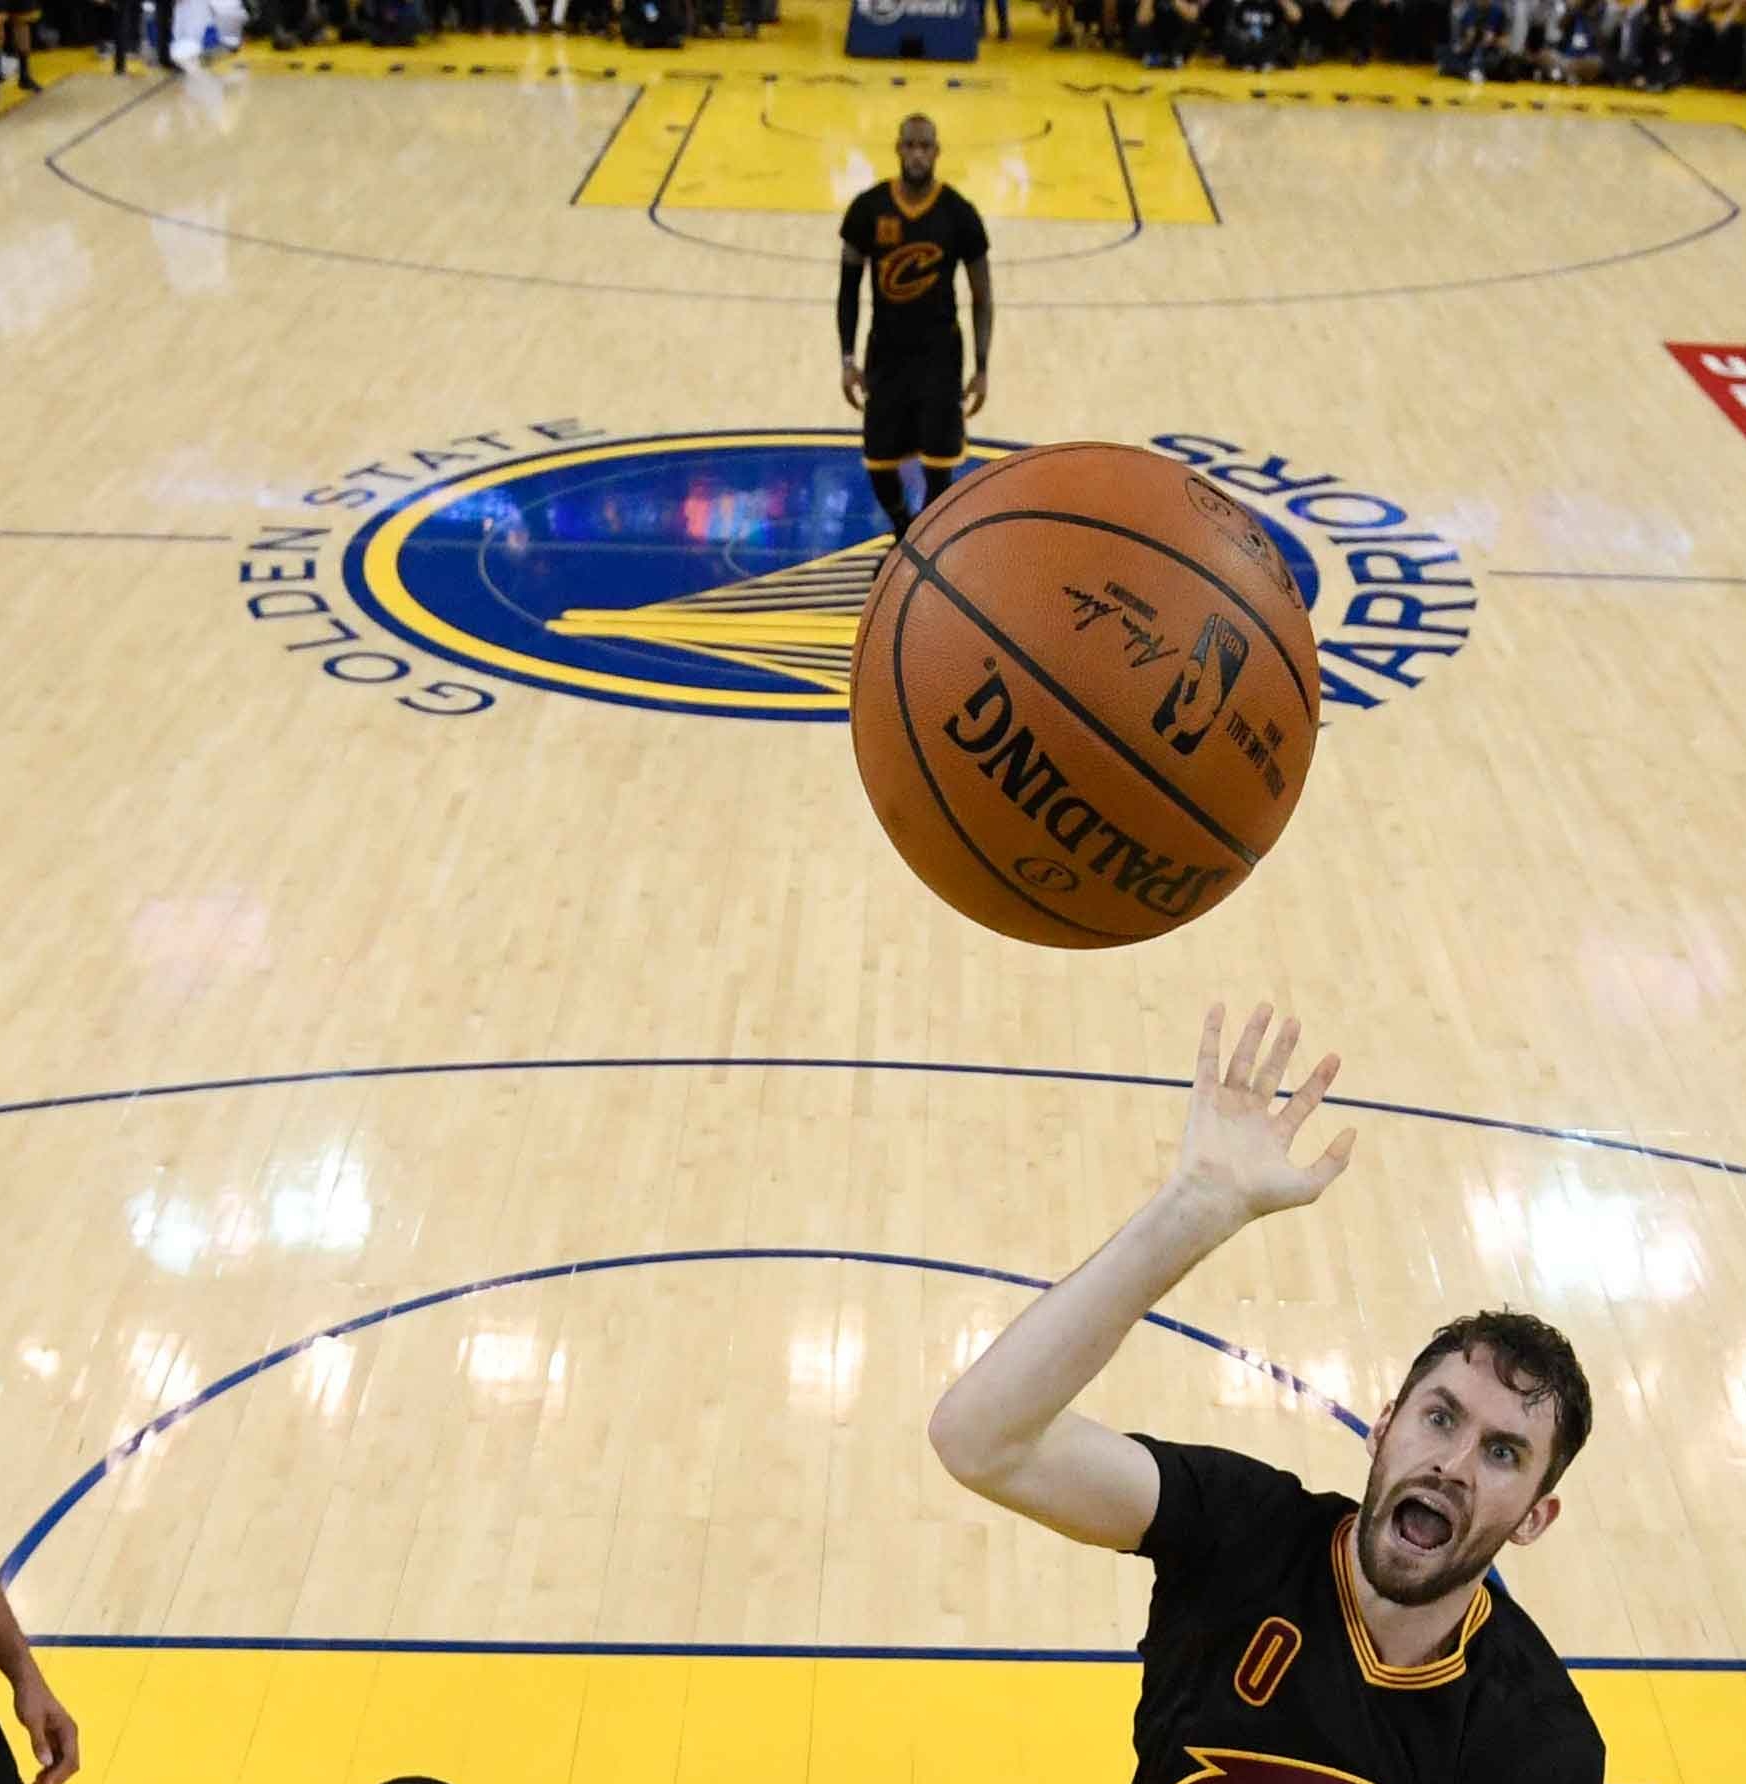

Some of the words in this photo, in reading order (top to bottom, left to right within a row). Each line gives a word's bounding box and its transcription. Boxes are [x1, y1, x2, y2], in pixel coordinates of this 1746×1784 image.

[303, 417, 607, 509] STATE
[239, 524, 497, 716] GOLDEN
[942, 670, 1231, 918] SPALDING
[1233, 1615, 1303, 1708] 0
